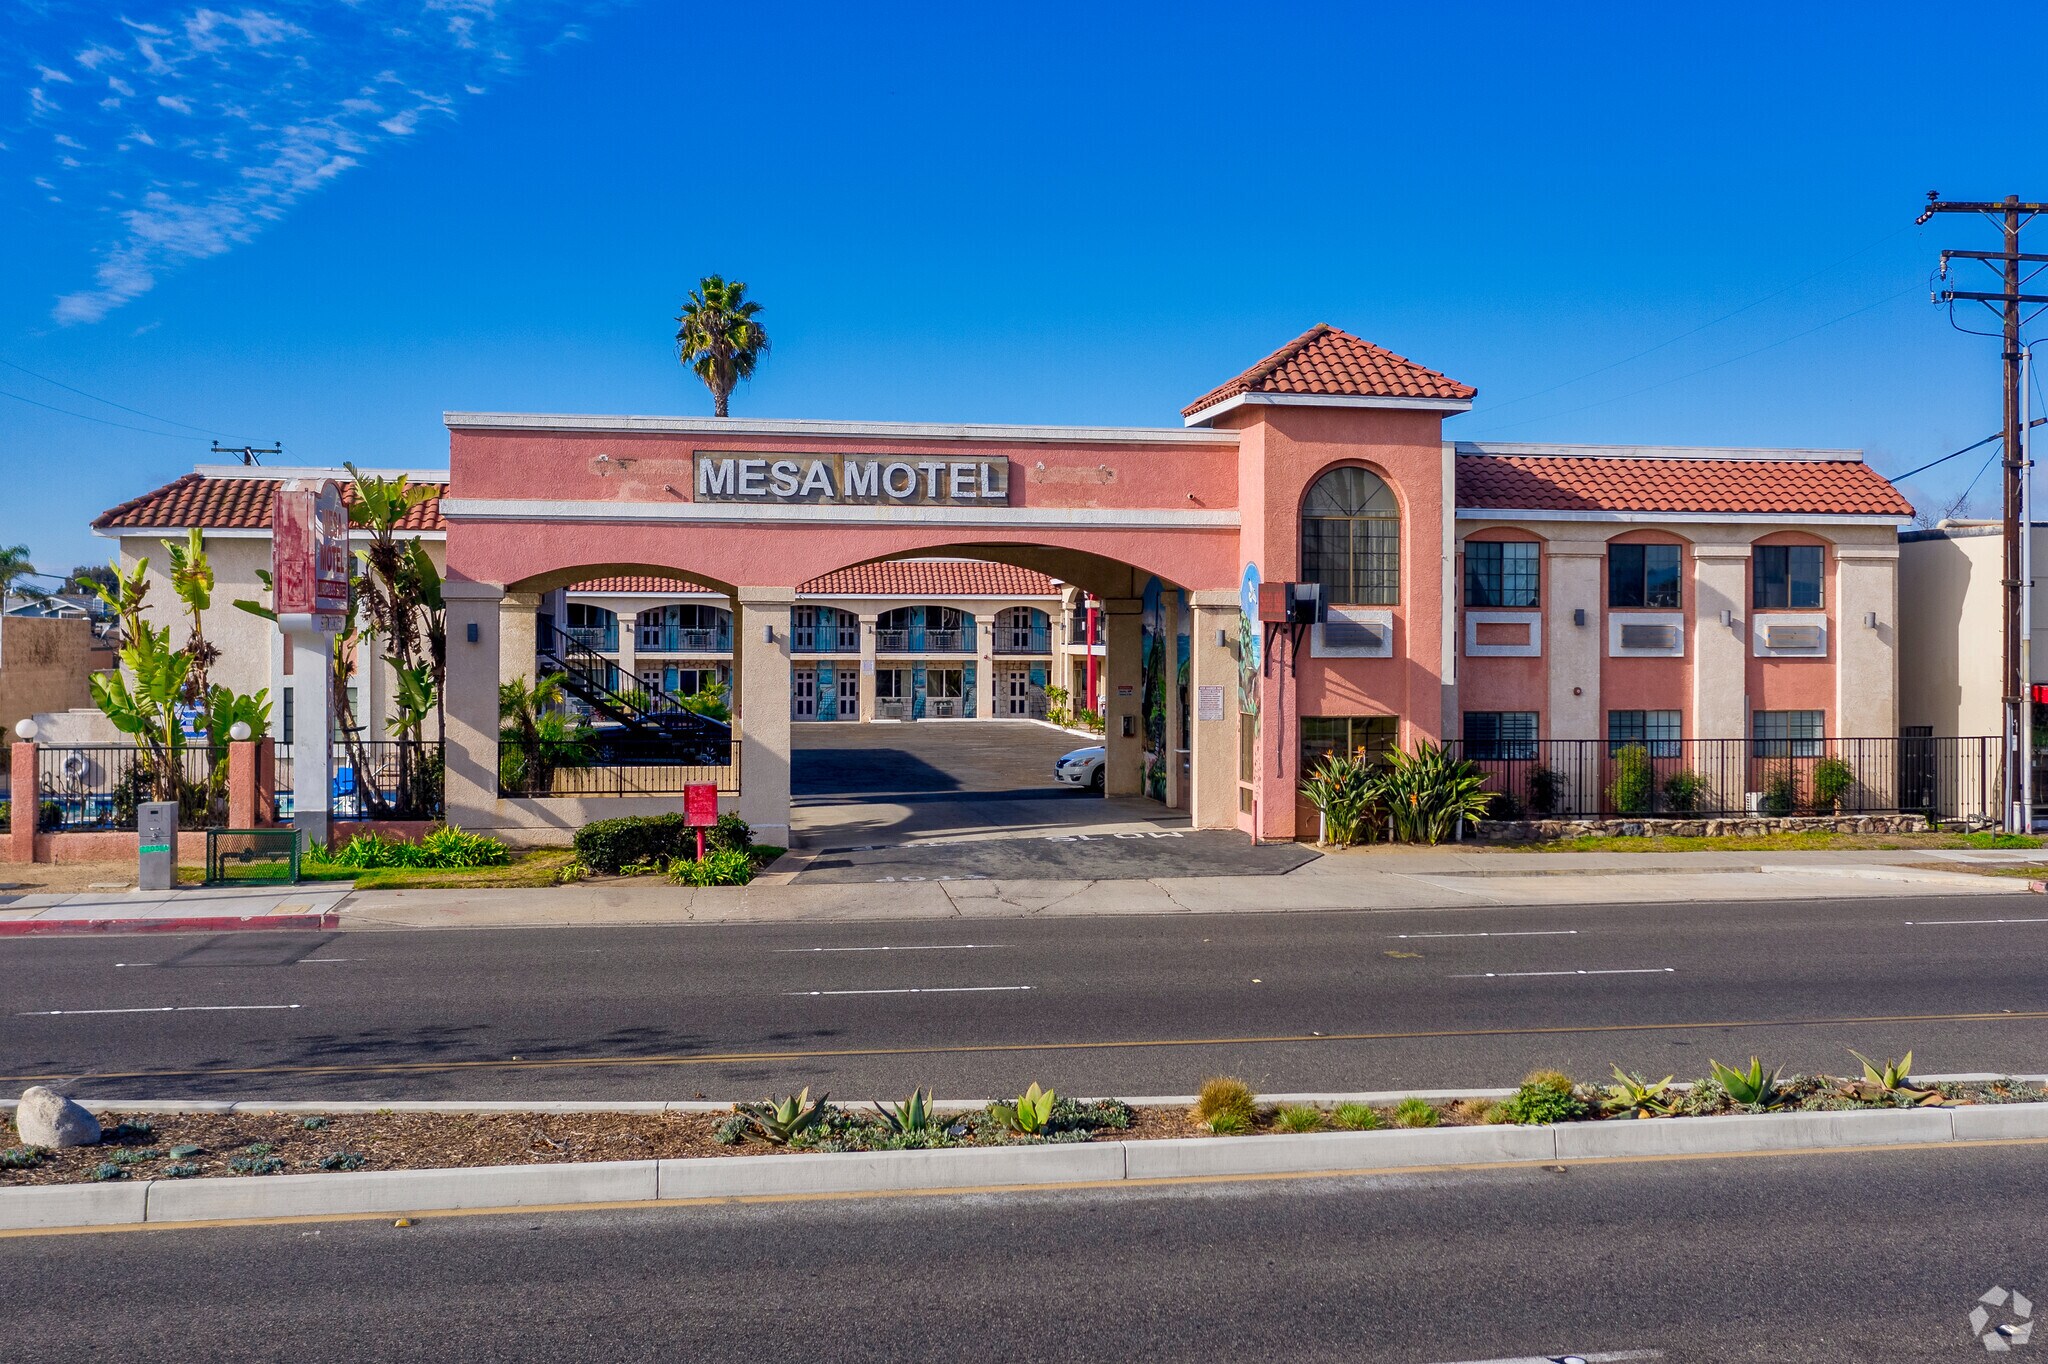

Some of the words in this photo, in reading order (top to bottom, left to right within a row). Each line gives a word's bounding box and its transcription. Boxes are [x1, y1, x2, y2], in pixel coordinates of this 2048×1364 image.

[699, 457, 834, 497] MESA
[844, 460, 1007, 498] MOTEL
[322, 508, 342, 538] MESA
[320, 545, 345, 573] MOTEL
